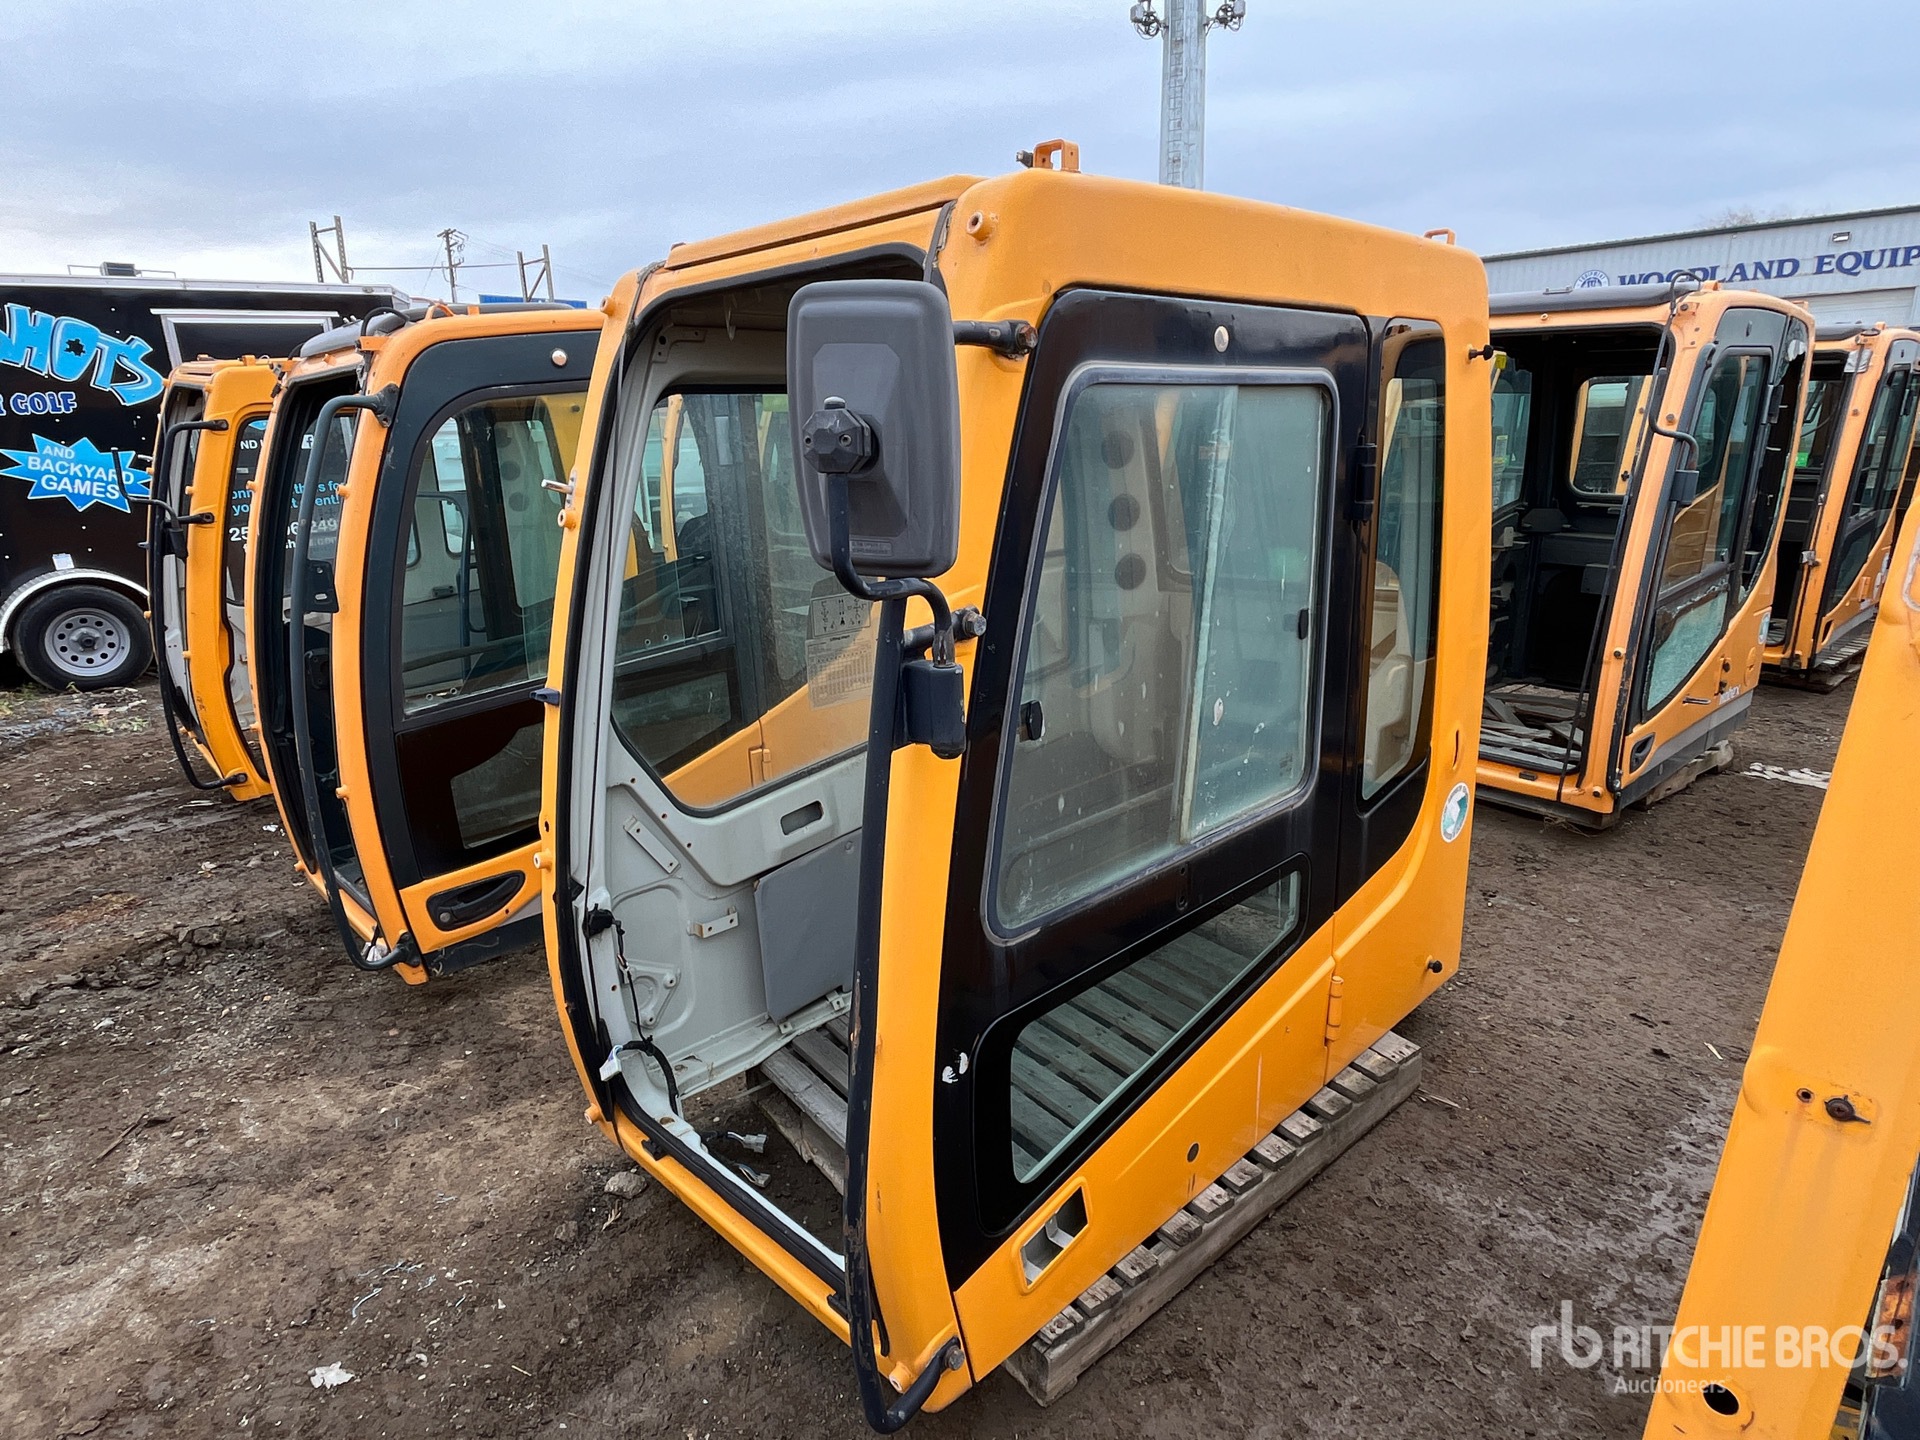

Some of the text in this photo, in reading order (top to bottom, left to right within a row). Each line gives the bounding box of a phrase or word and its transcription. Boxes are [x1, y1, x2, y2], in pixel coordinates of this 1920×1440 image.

[1814, 245, 1920, 277] EQUIP
[0, 303, 165, 406] HOTS
[10, 391, 77, 415] GOLF
[42, 445, 75, 460] AND
[27, 456, 134, 485] BACKYARD
[41, 474, 120, 499] GAMES
